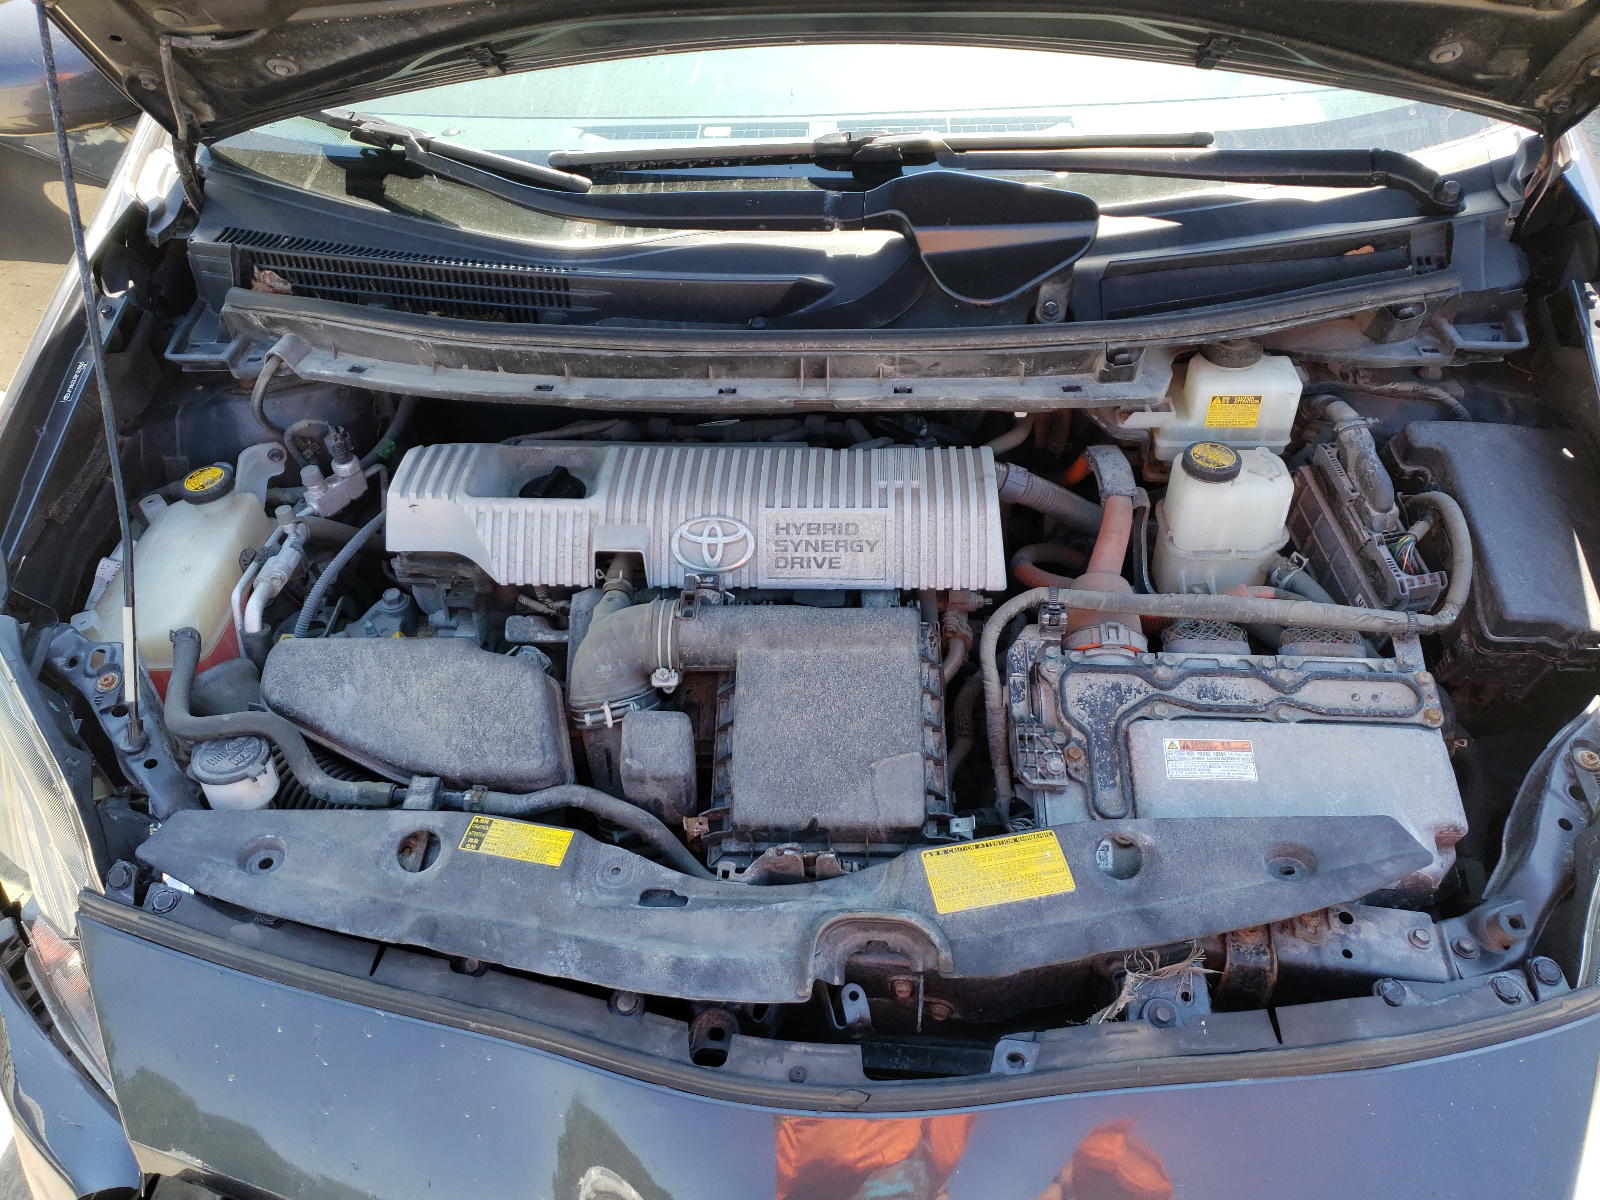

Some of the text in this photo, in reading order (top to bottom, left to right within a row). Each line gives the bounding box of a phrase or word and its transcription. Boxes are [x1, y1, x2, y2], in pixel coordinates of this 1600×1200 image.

[774, 522, 859, 536] HYBRID
[774, 539, 880, 553] SYNERGY
[774, 556, 842, 570] DRIVE
[979, 837, 1014, 849] ATTENTION
